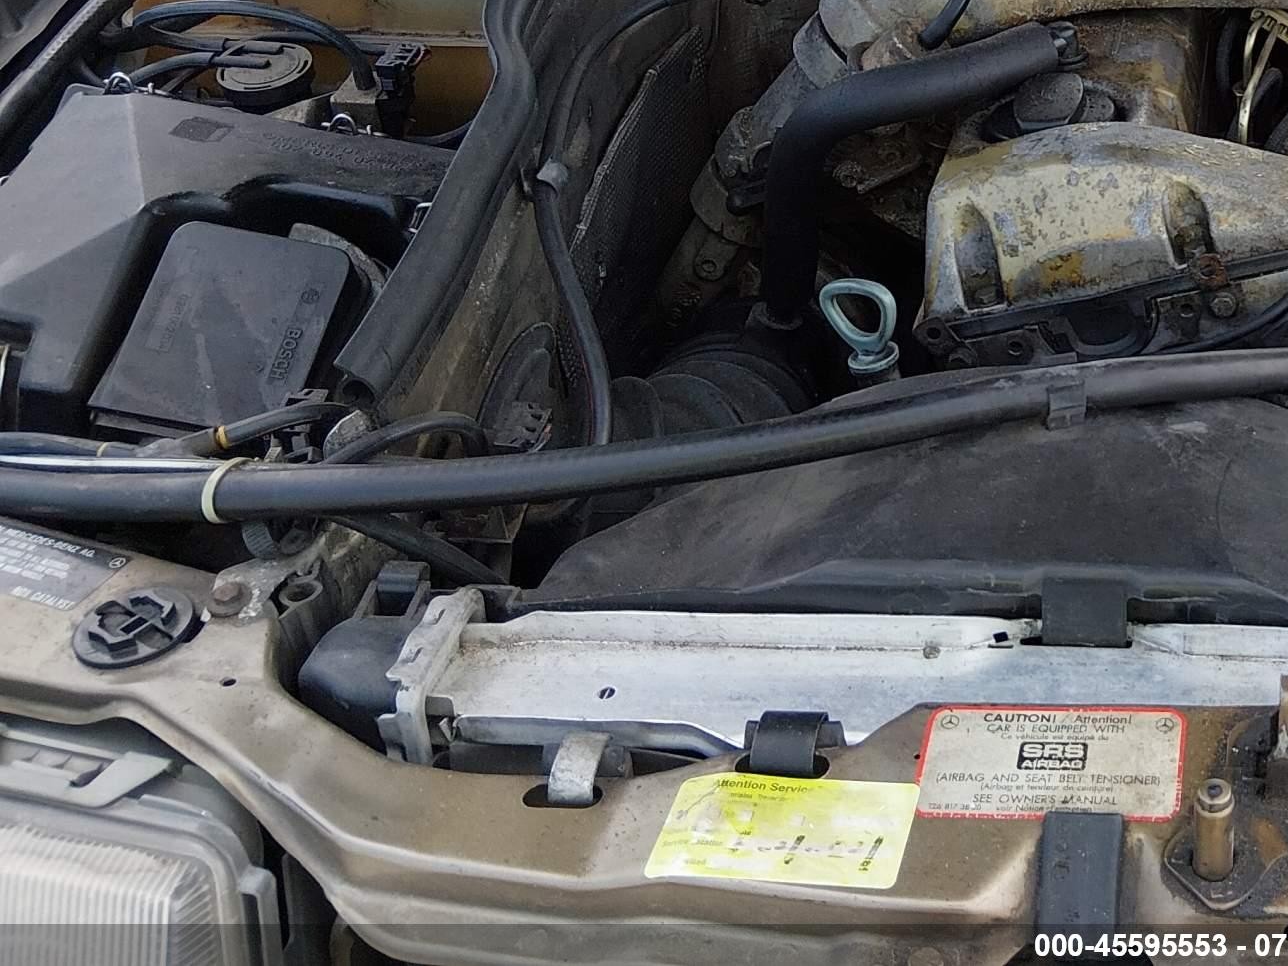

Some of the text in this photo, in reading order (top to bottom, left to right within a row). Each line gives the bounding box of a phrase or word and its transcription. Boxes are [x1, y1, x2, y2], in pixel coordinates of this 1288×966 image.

[270, 328, 302, 380] BOSCH
[6, 528, 81, 553] MERCEDES-BENZ
[30, 592, 76, 610] CATALYST
[984, 713, 1056, 723] CAUTION!
[1074, 715, 1132, 724] Attention!
[986, 724, 1125, 733] CAR IS EQUIPPED WITH
[1021, 744, 1085, 759] SRS
[1021, 759, 1083, 770] AIRBAG
[936, 773, 1161, 786] (AIRBAG AND SEAT BELT TENSIONER)
[973, 794, 1118, 805] SEE OWNER'S MANUAL
